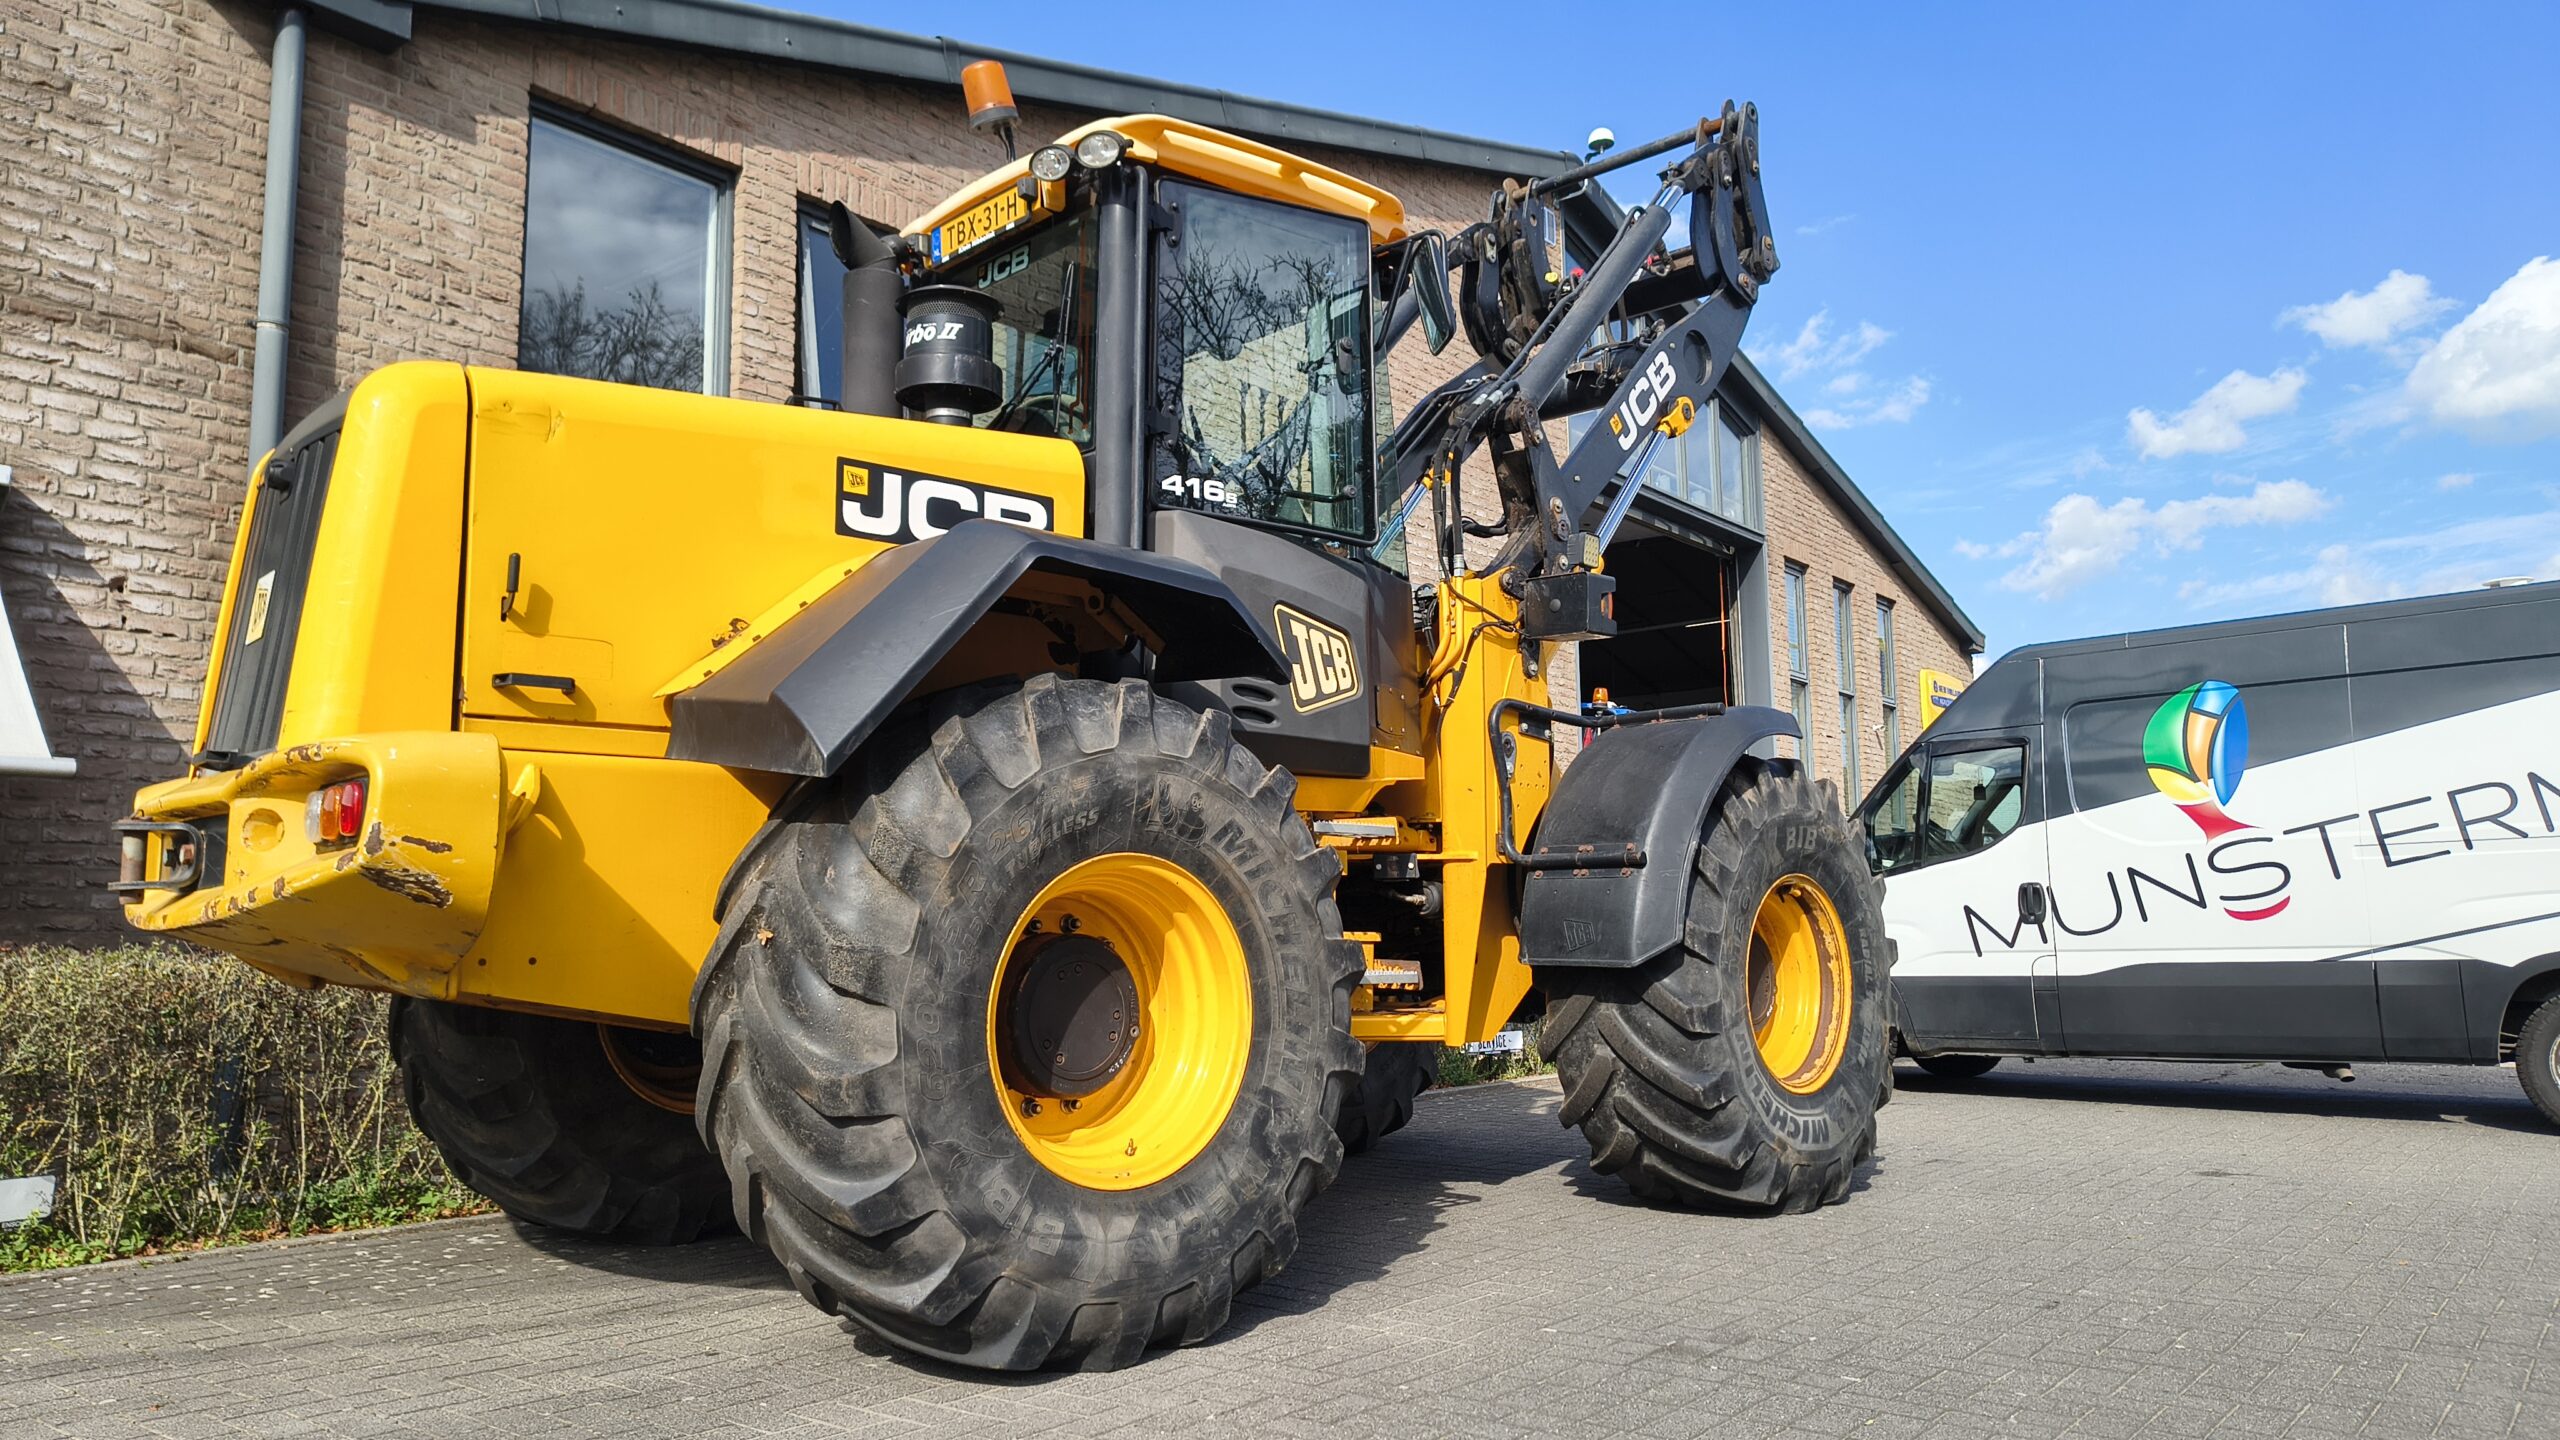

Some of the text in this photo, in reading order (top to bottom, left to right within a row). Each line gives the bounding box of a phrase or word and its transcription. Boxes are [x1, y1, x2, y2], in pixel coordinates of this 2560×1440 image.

[947, 192, 1018, 250] TBX-31-H
[978, 243, 1030, 289] JCB
[1618, 350, 1677, 451] JCB
[1289, 618, 1352, 701] JCB
[1210, 817, 1313, 1096] MICHELIN
[1734, 1029, 1830, 1145] MICHELIN
